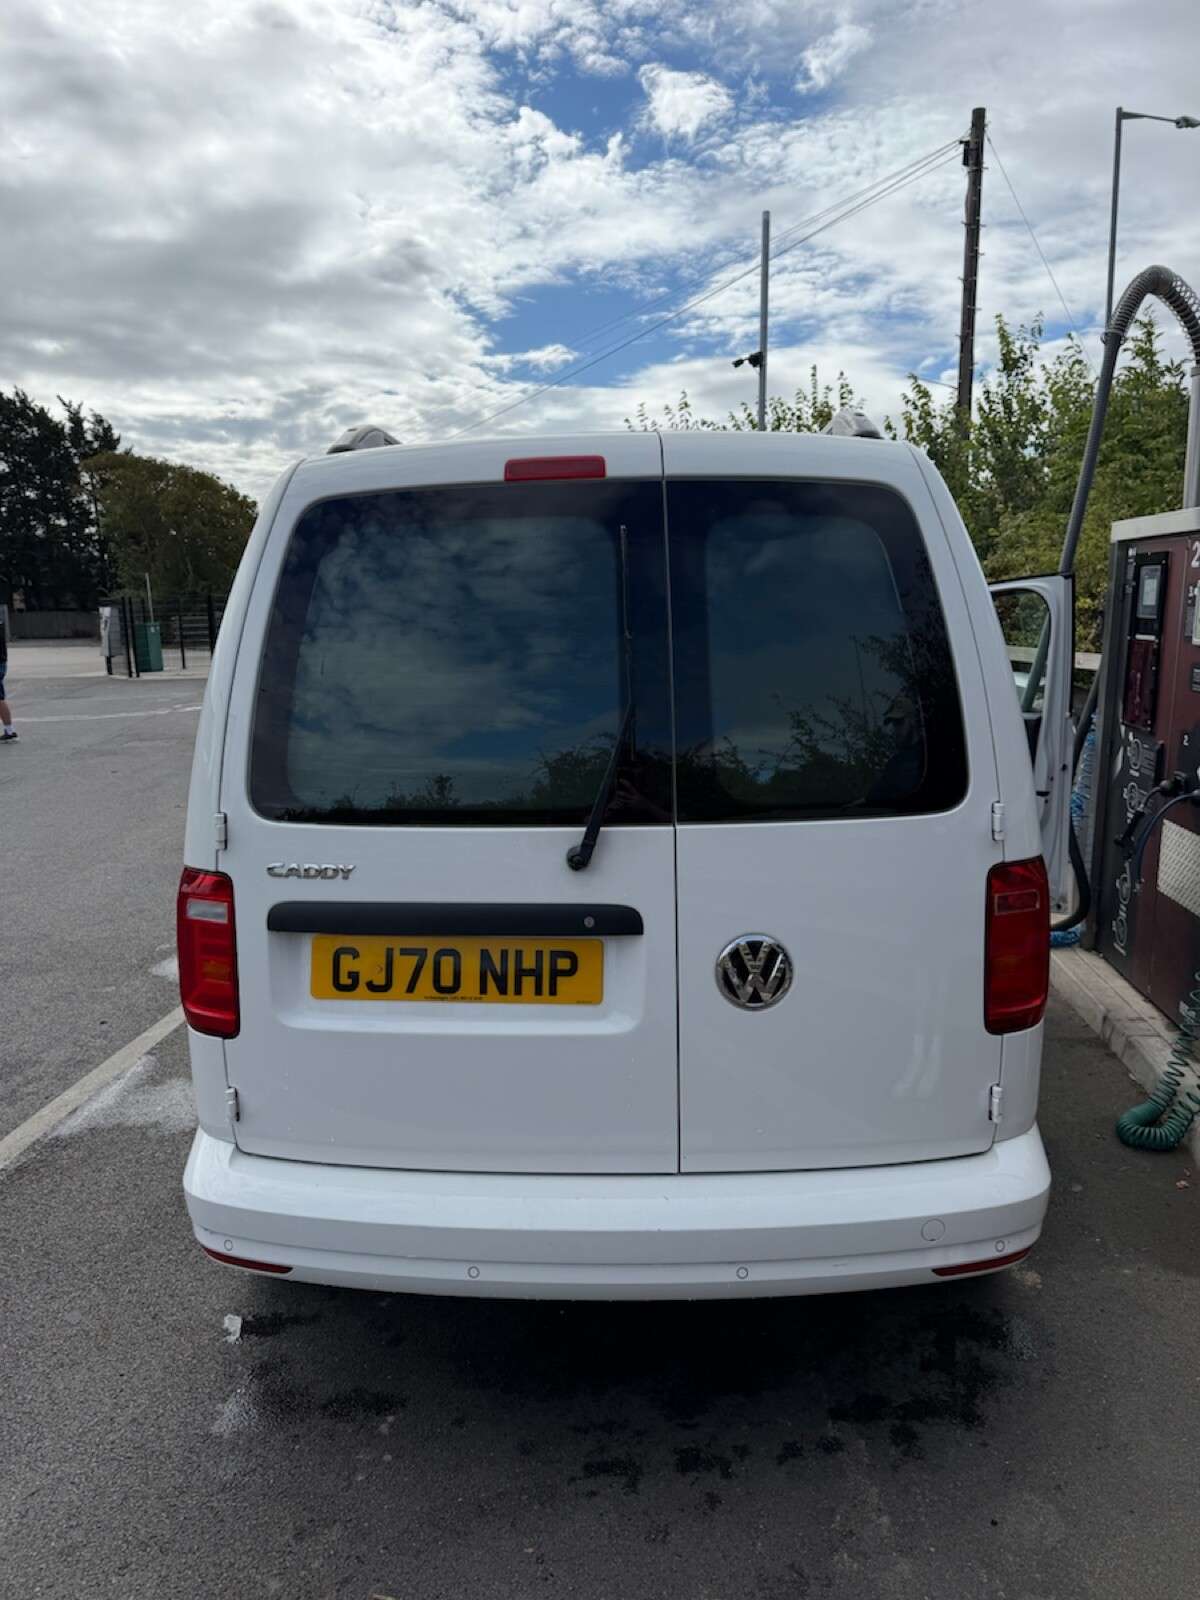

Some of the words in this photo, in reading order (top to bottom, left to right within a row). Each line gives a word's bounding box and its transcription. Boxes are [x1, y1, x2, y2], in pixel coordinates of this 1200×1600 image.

[266, 862, 356, 880] CADDY
[332, 947, 462, 995] GJ70
[479, 948, 579, 996] NHP
